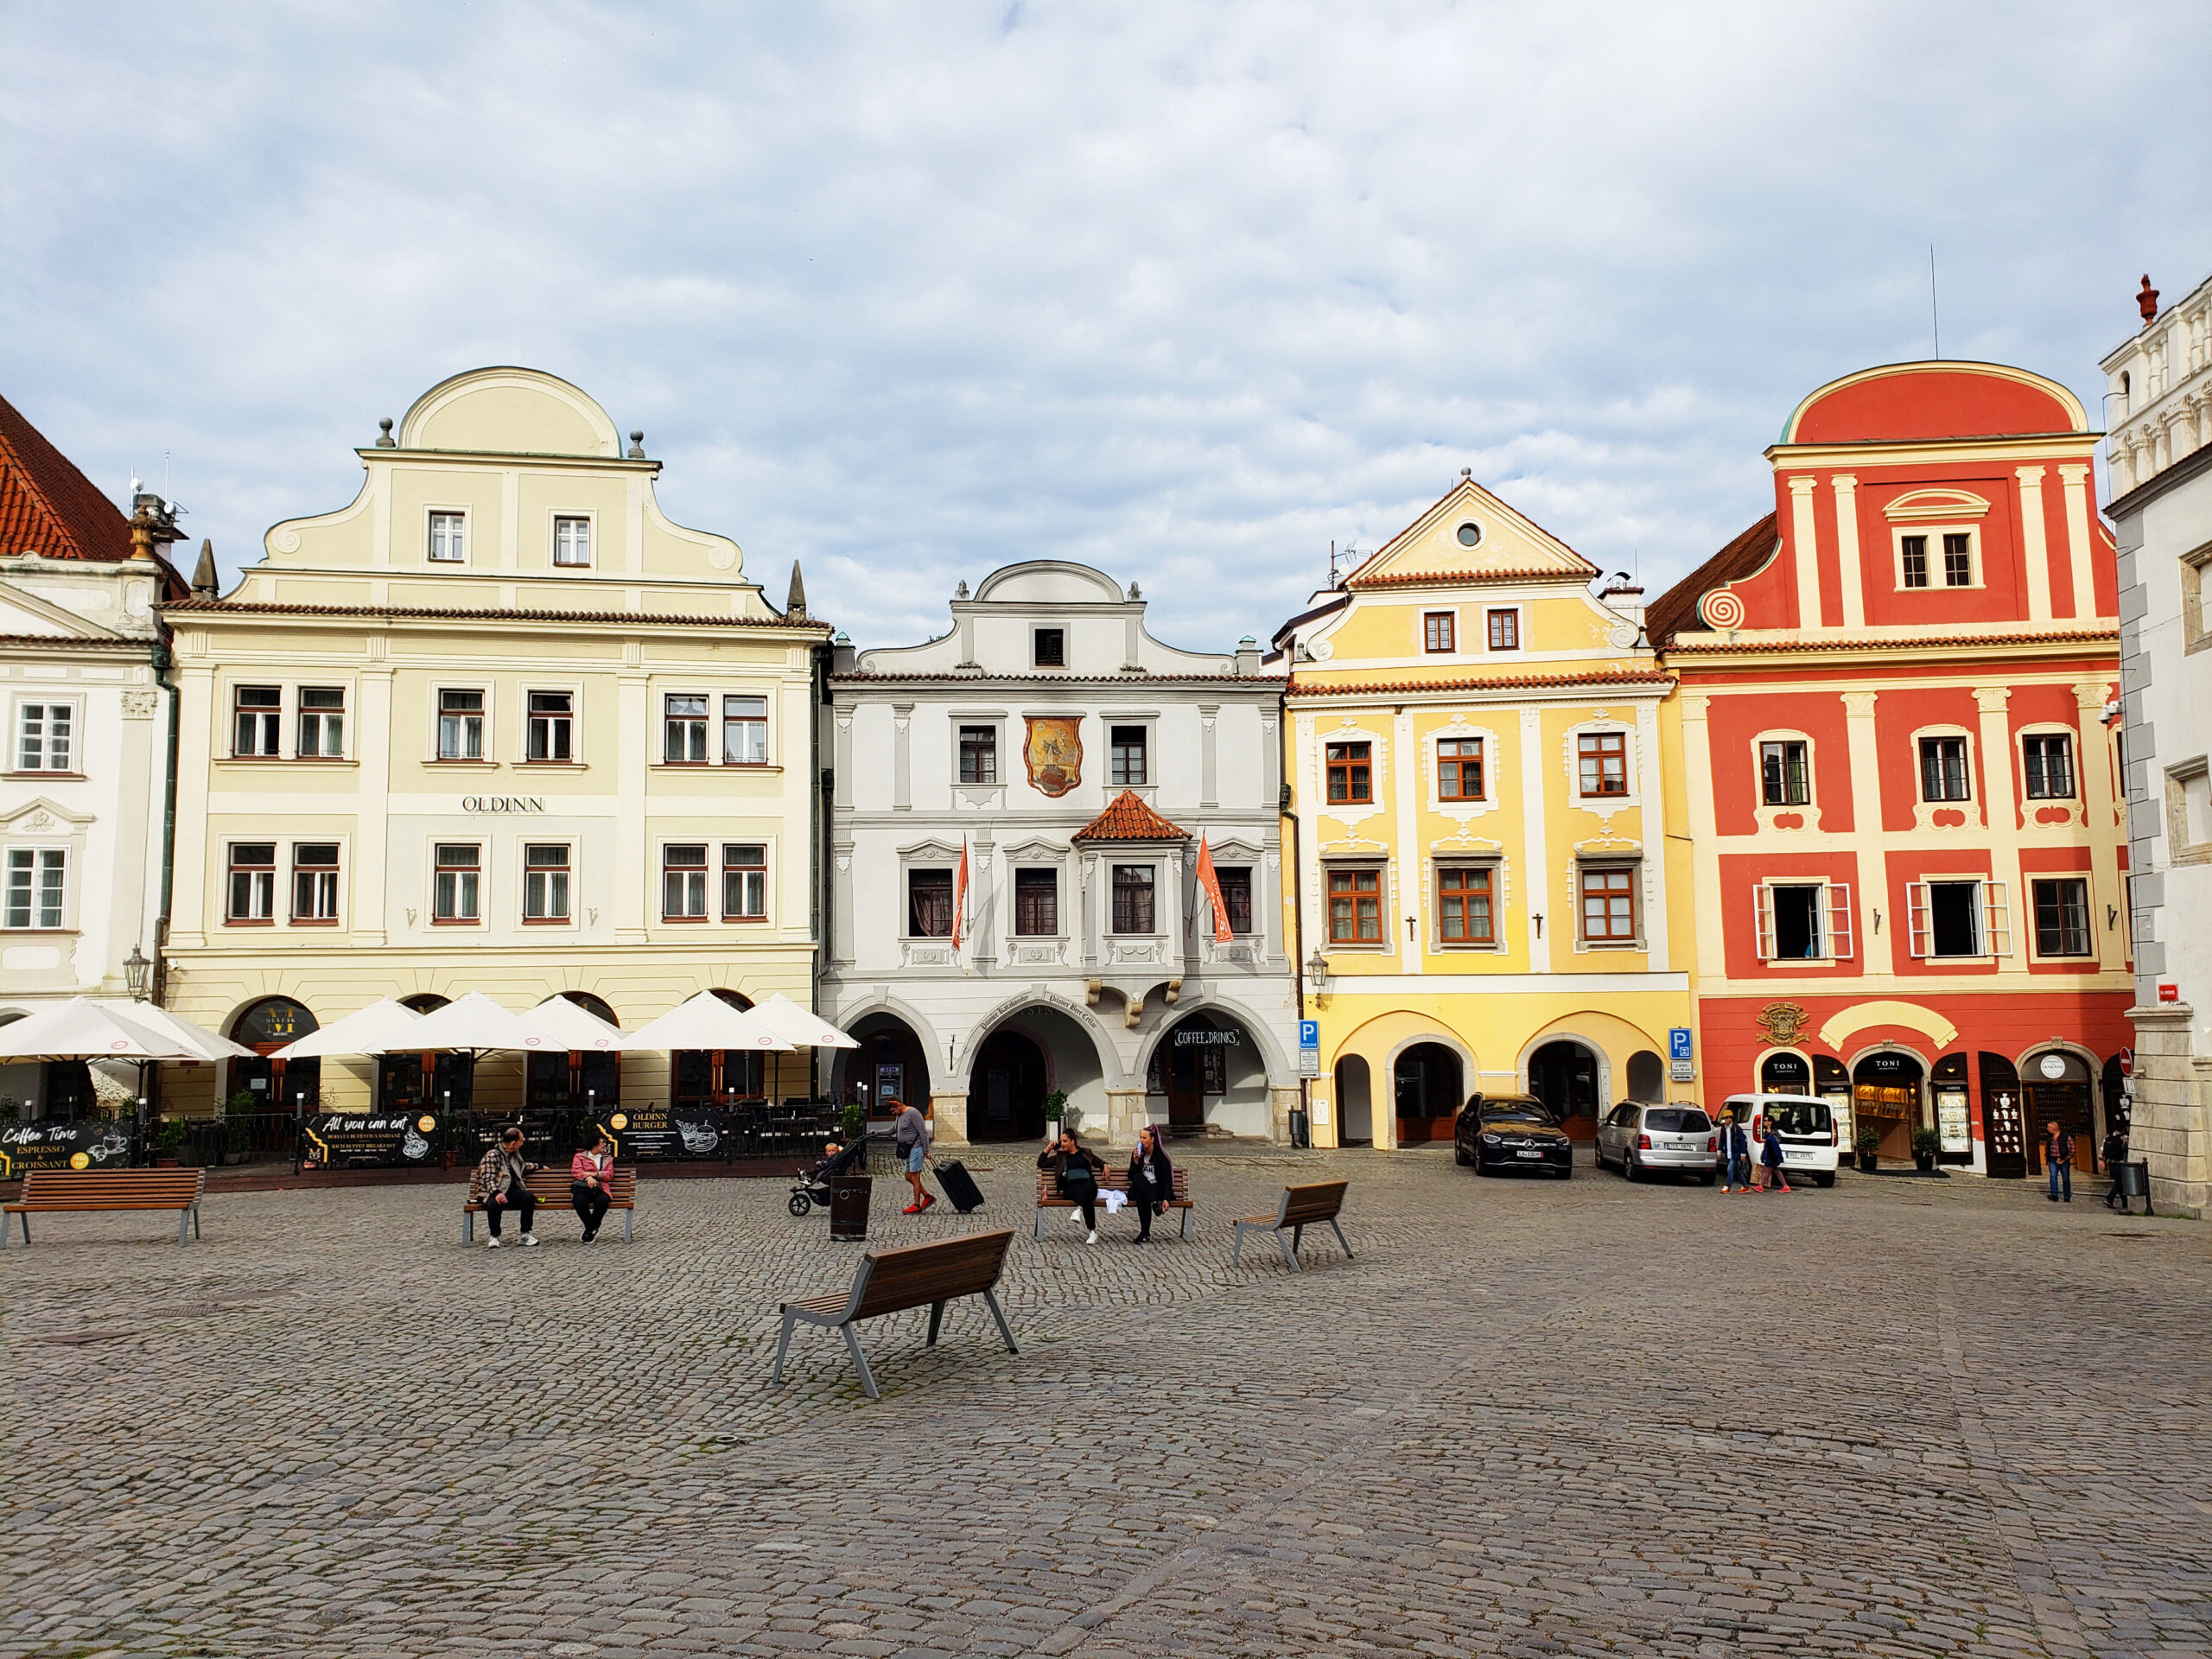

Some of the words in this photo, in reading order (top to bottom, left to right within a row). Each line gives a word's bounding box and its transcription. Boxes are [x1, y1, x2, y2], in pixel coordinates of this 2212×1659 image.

[462, 796, 543, 811] OLDINN
[1303, 1023, 1314, 1040] P
[1674, 1032, 1687, 1049] P
[322, 1116, 343, 1132] All
[344, 1119, 365, 1131] you
[367, 1119, 387, 1130] can
[390, 1116, 409, 1130] eat
[2, 1127, 42, 1145] Coffee
[47, 1126, 78, 1141] Time
[16, 1145, 66, 1154] ESPRESSO
[11, 1160, 68, 1170] CROISSANT
